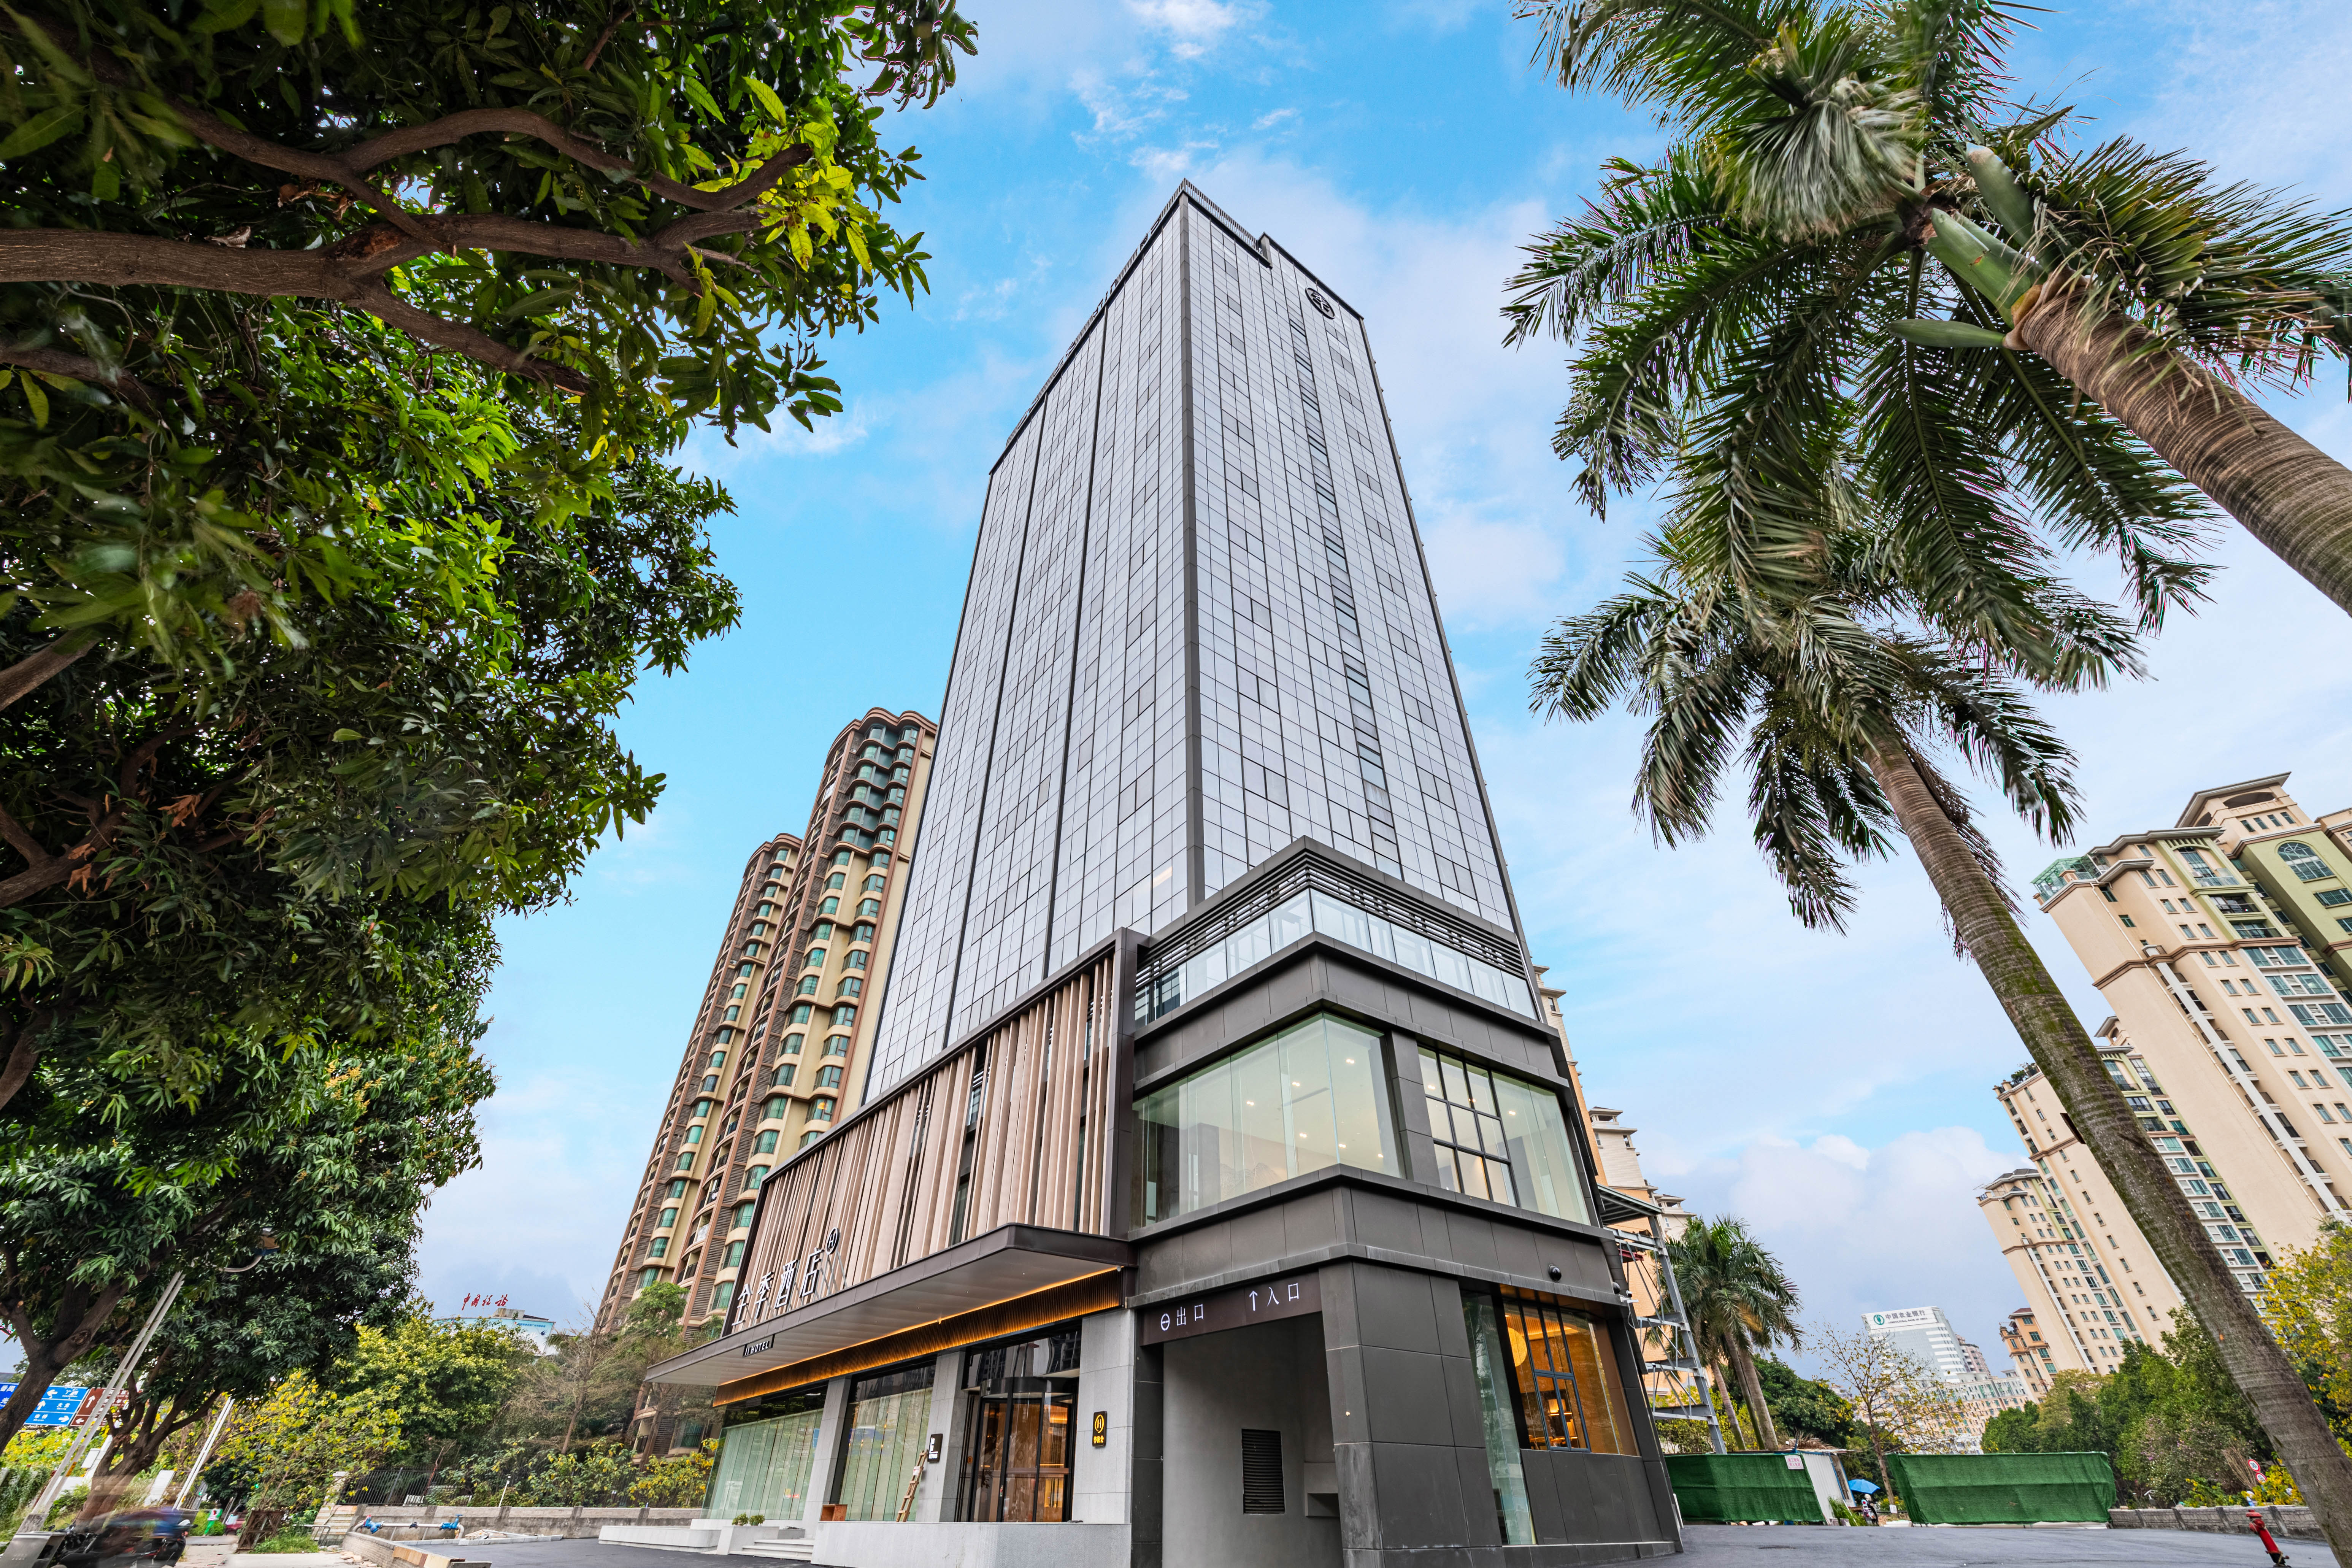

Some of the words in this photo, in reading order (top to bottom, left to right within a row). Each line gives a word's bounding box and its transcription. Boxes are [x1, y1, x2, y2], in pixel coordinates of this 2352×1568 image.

[732, 1247, 824, 1326] 全季酒店
[1267, 1282, 1299, 1307] 入口
[1177, 1304, 1203, 1326] 出口
[1885, 1310, 1925, 1319] 中国农业银行
[751, 1340, 768, 1354] HOTEL
